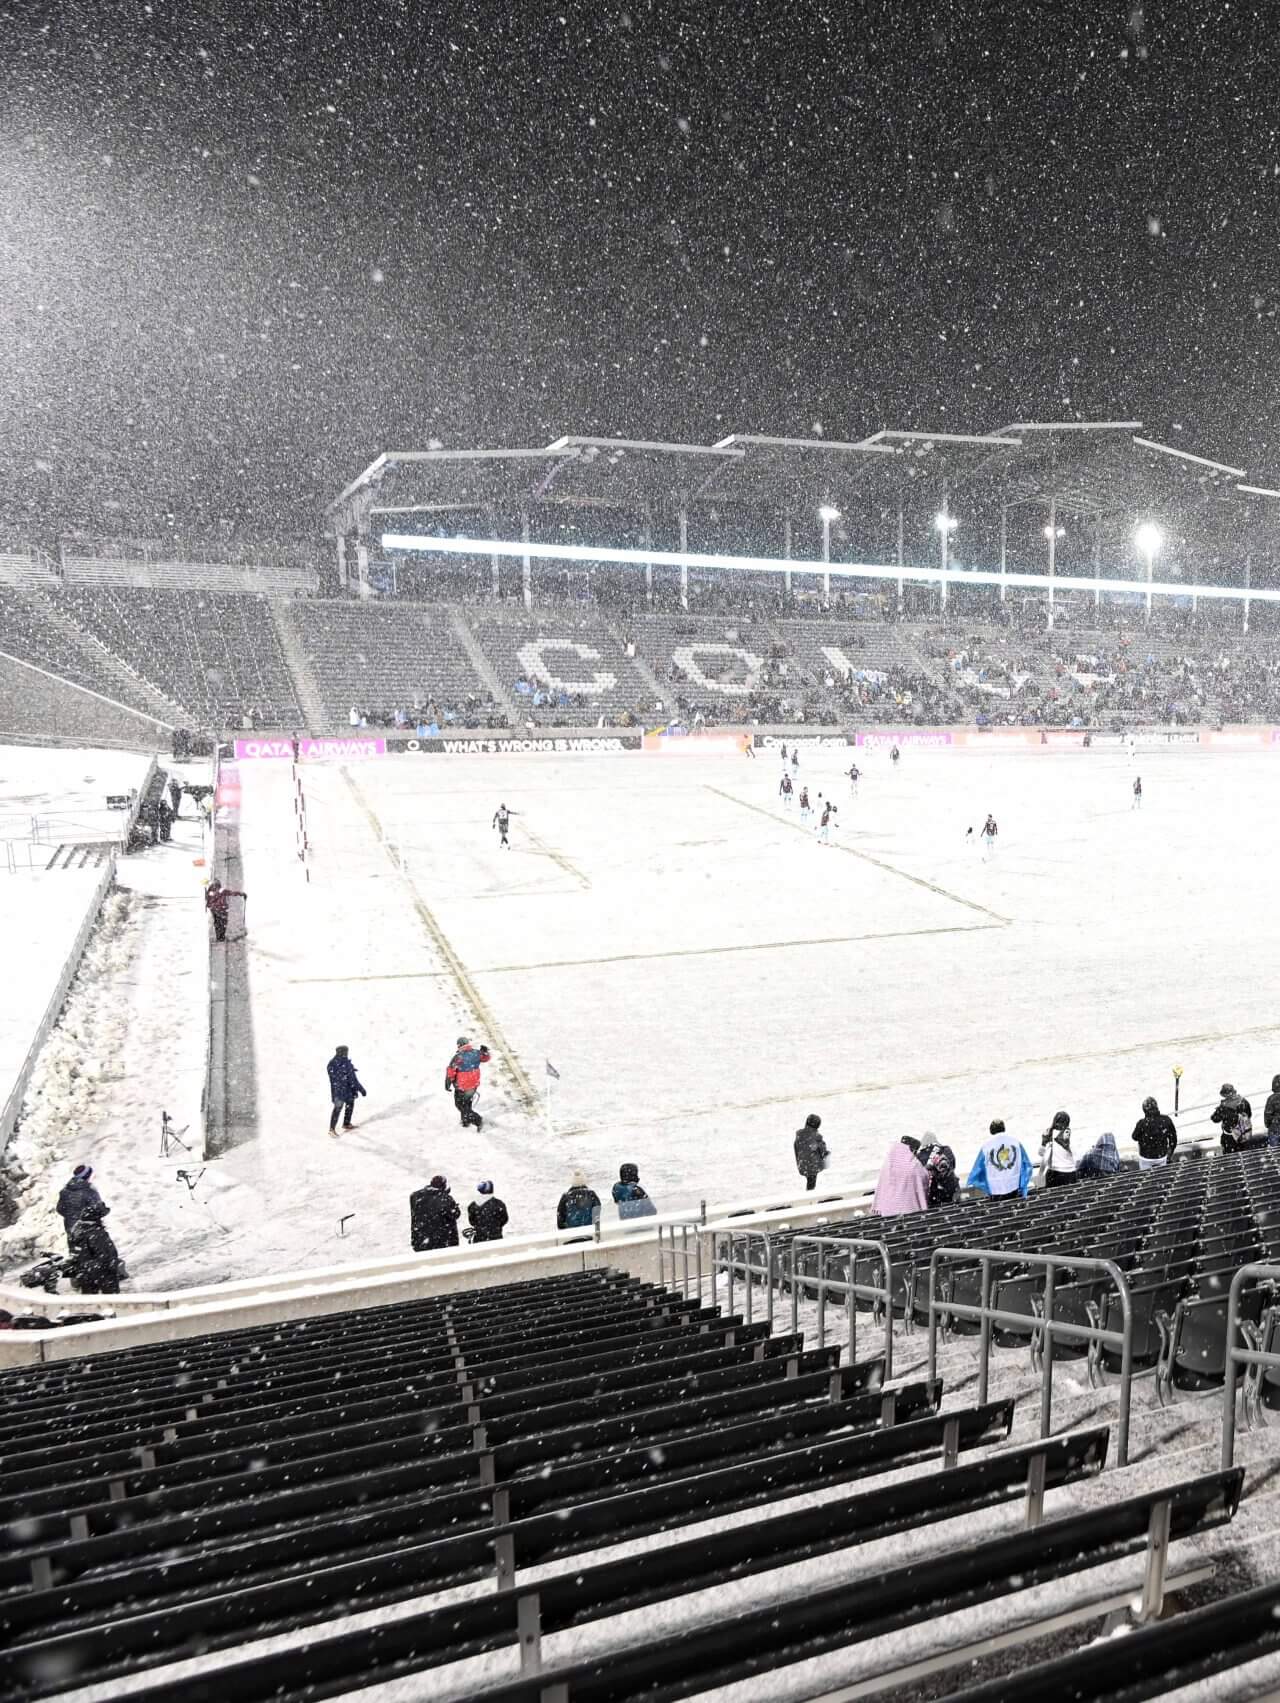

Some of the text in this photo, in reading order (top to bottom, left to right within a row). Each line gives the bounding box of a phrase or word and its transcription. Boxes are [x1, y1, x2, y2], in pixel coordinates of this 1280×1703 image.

[308, 740, 377, 757] AIRWAYS
[443, 740, 497, 753] WHAT'S
[499, 740, 552, 753] WRONG
